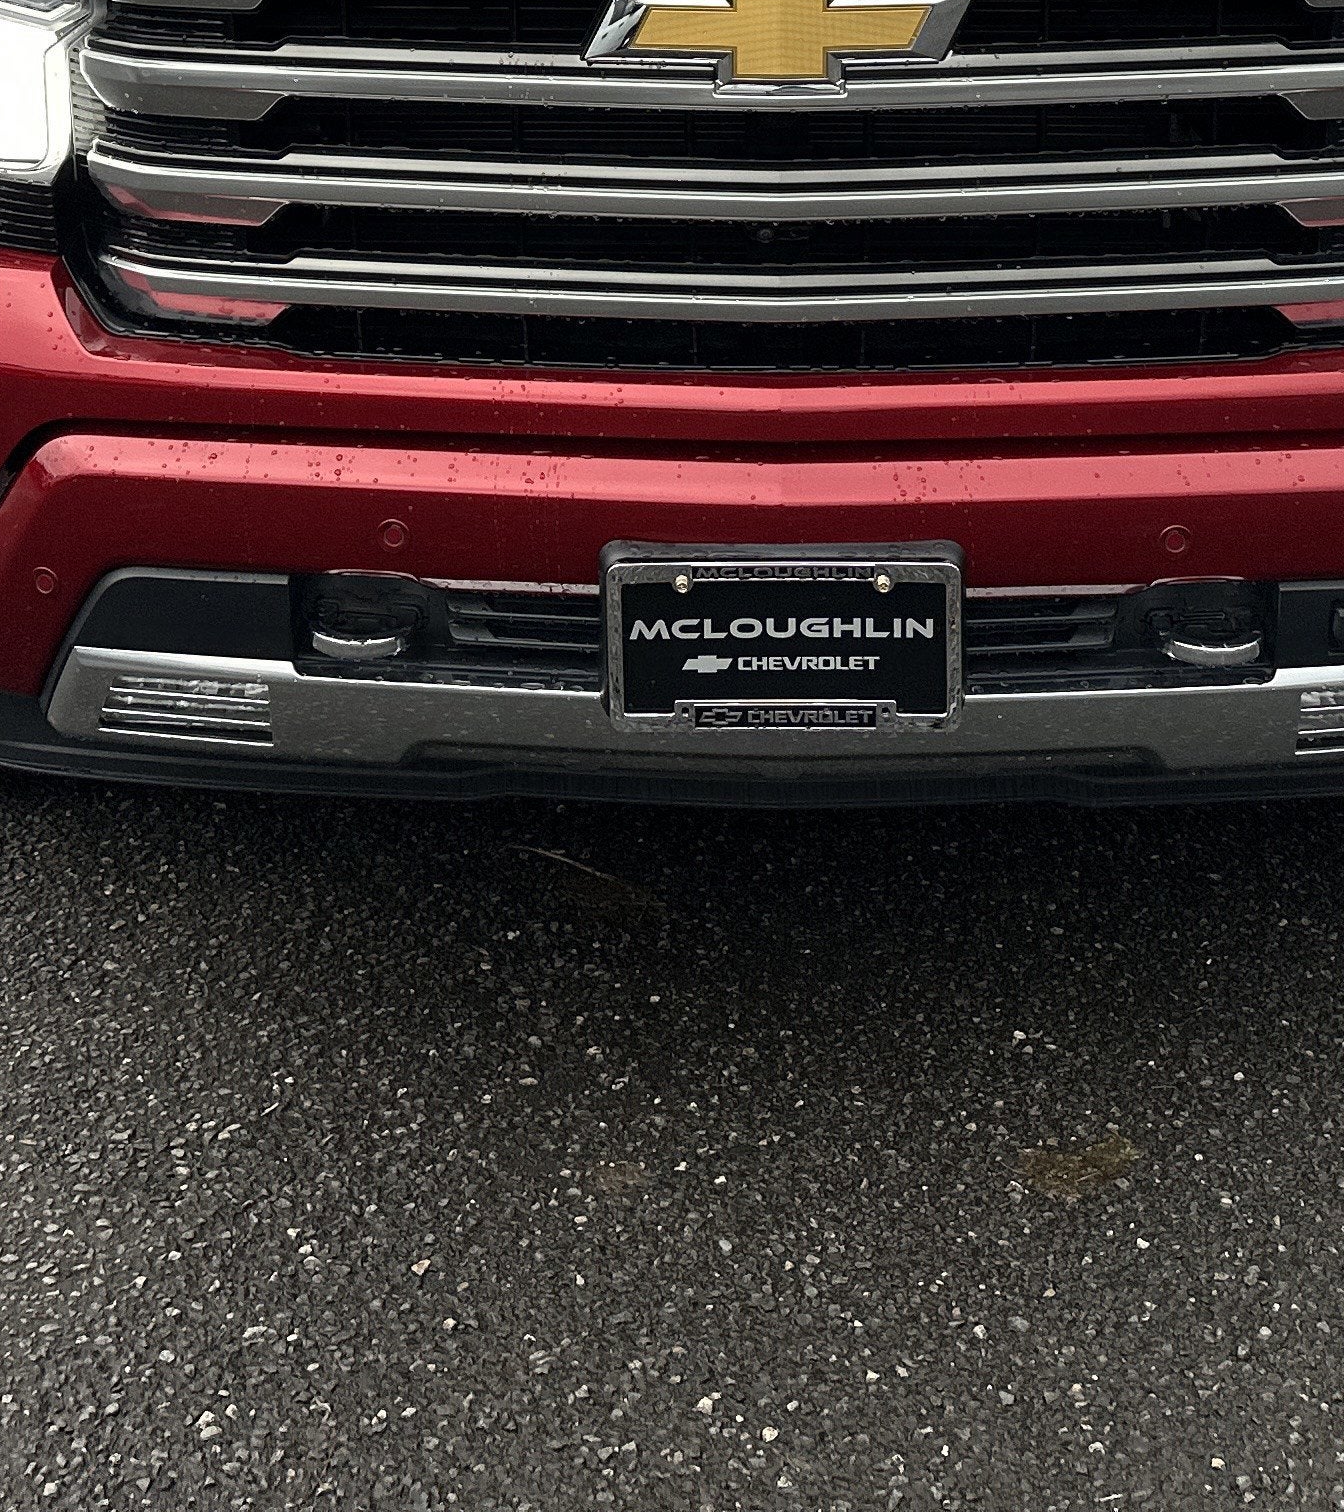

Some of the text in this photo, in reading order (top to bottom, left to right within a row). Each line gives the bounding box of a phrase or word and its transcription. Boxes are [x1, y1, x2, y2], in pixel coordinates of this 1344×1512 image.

[695, 566, 873, 579] MCLOUGHLIN
[629, 617, 934, 640] MCLOUGHLIN
[737, 656, 881, 671] CHEVROLET
[747, 710, 874, 724] CHEVROLET
